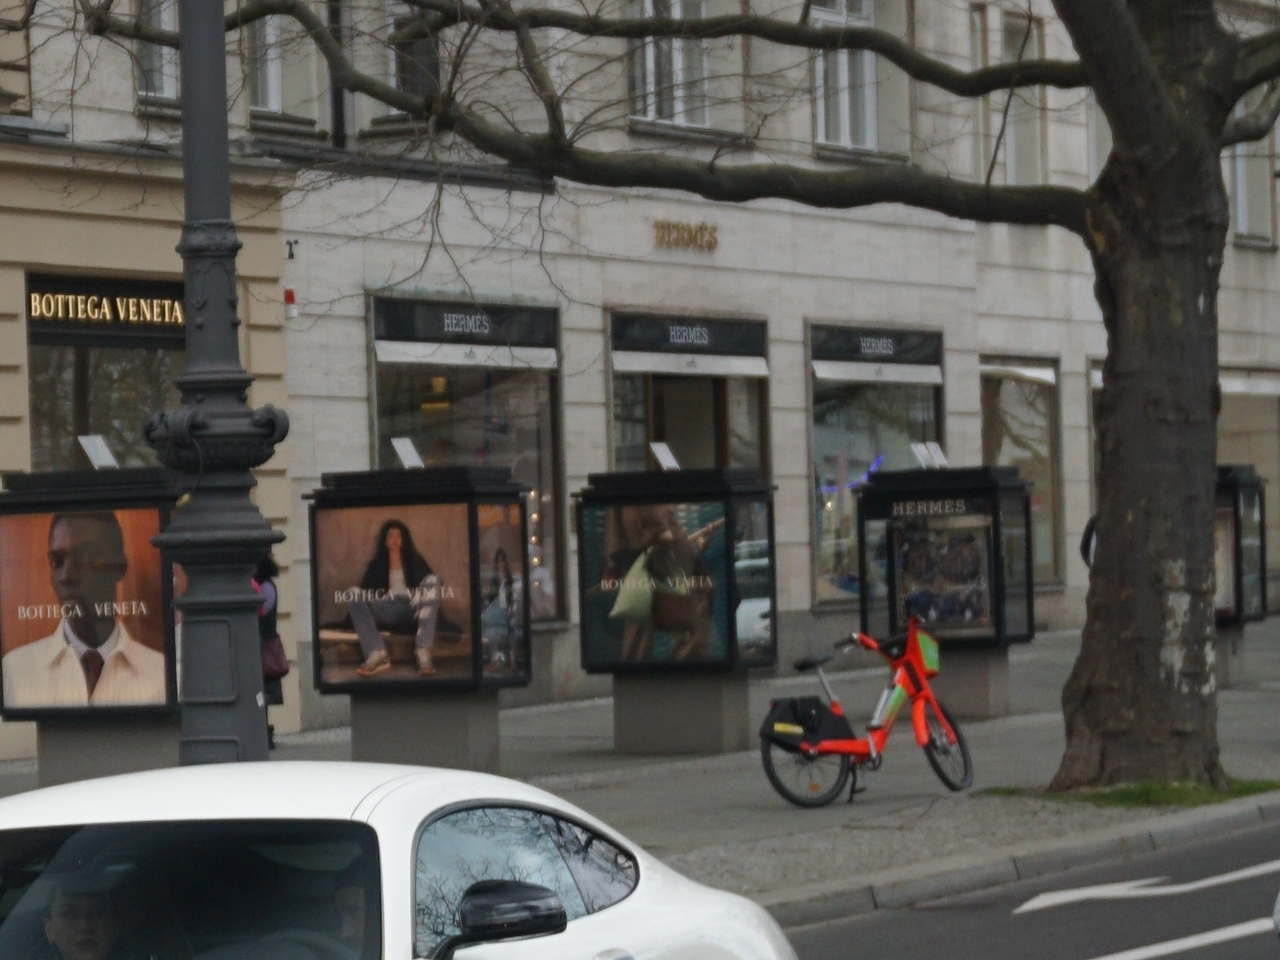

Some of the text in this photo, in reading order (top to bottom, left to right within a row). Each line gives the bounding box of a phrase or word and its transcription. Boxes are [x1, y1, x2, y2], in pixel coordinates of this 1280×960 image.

[30, 292, 184, 324] BOTTEGA VENETA
[334, 588, 394, 604] BOTTEGA
[17, 600, 147, 620] BOTTEGA VENETA
